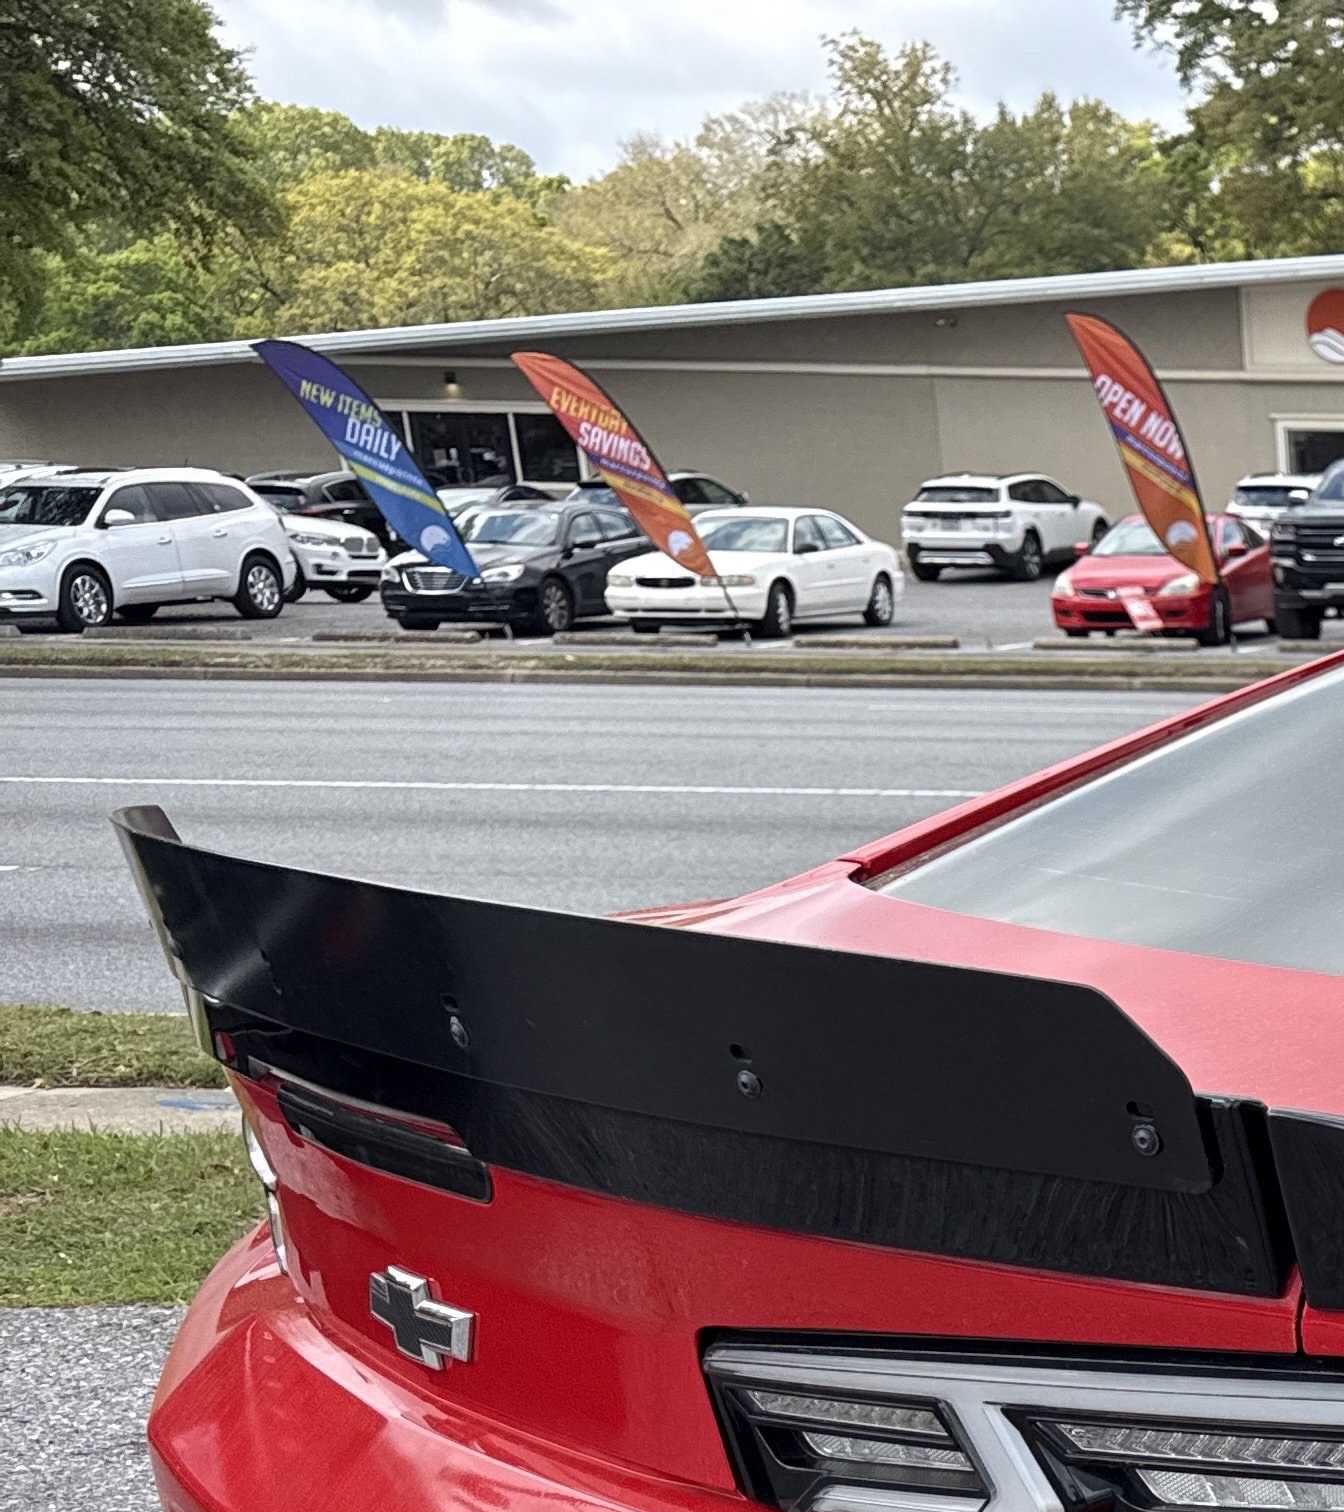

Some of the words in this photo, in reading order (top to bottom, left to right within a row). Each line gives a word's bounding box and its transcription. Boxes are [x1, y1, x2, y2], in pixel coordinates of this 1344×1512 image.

[300, 380, 336, 408] NEW
[337, 394, 383, 427] ITEMS
[1095, 374, 1147, 427] OPEN
[1139, 410, 1184, 460] NOW
[345, 418, 402, 460] DAILY
[578, 422, 651, 471] SAVINGS
